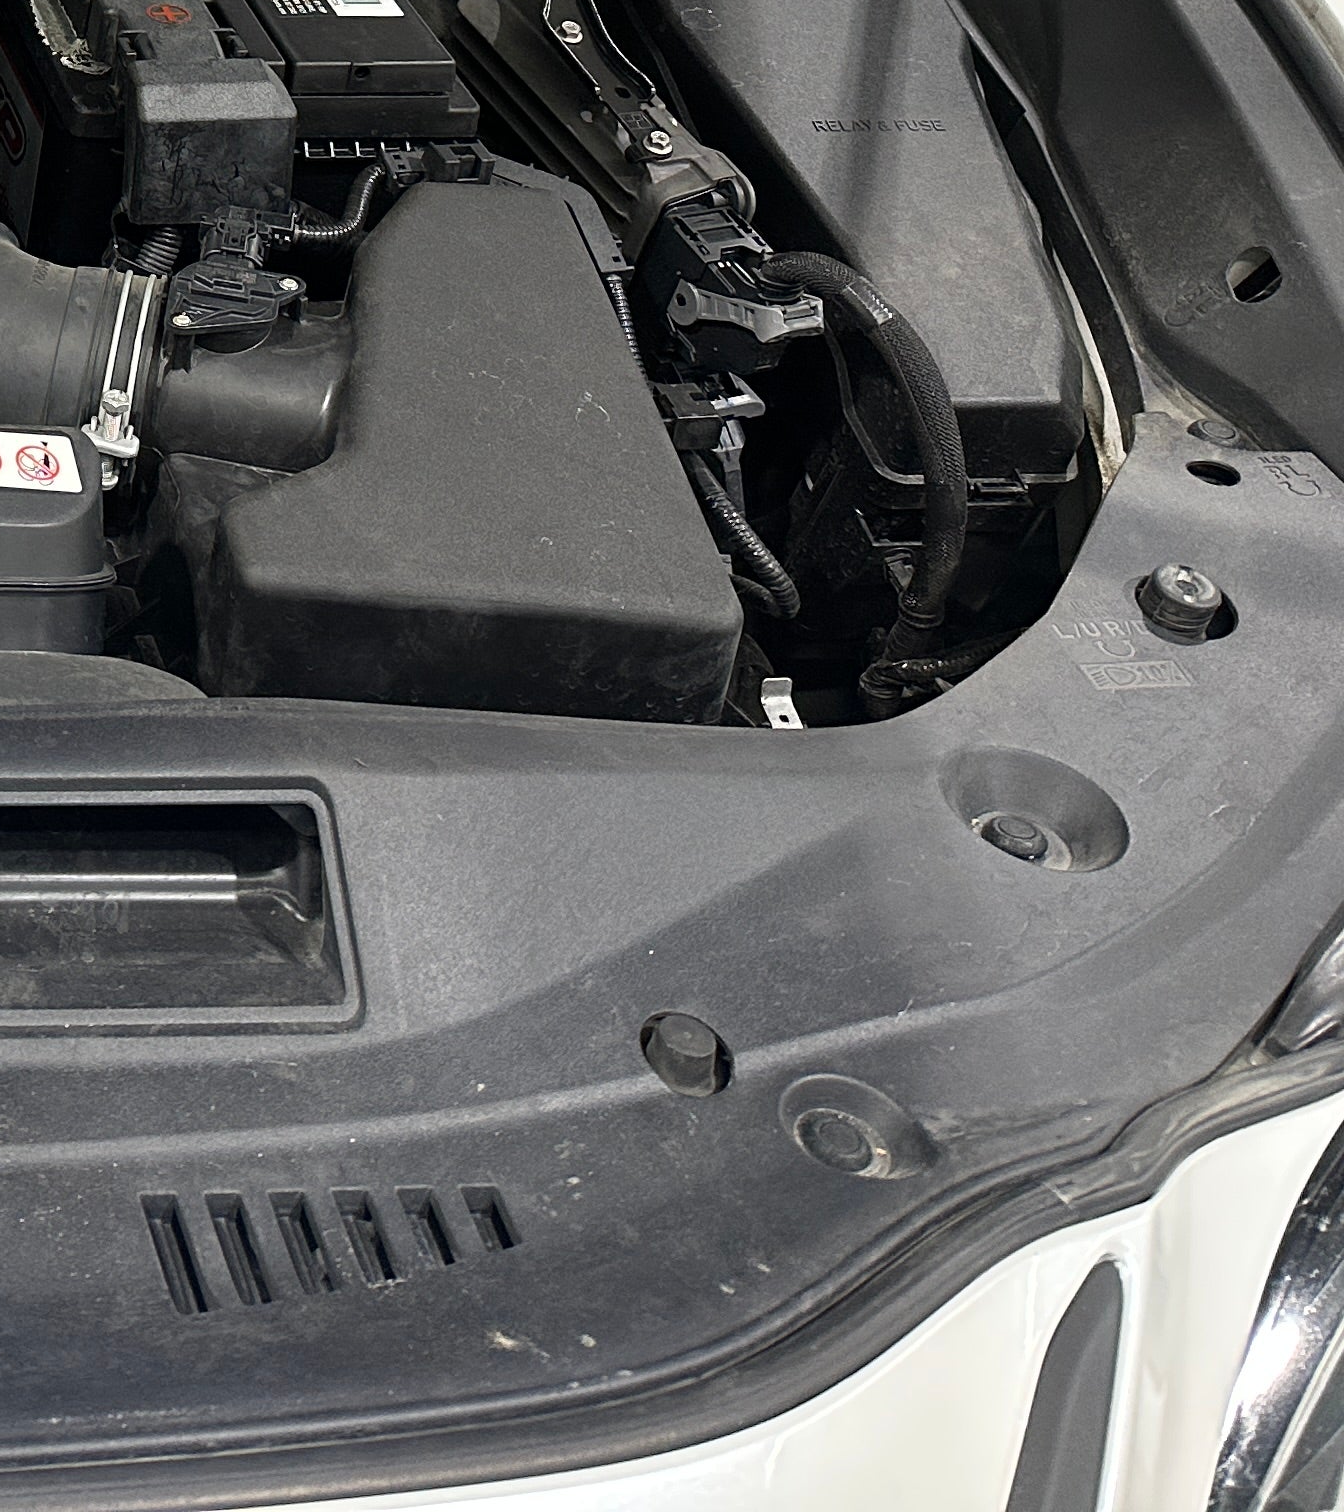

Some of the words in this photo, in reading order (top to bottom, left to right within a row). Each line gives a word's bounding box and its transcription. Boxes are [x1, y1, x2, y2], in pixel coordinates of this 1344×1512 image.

[812, 120, 872, 132] RELAY
[878, 121, 890, 132] &
[894, 120, 946, 132] FUSE
